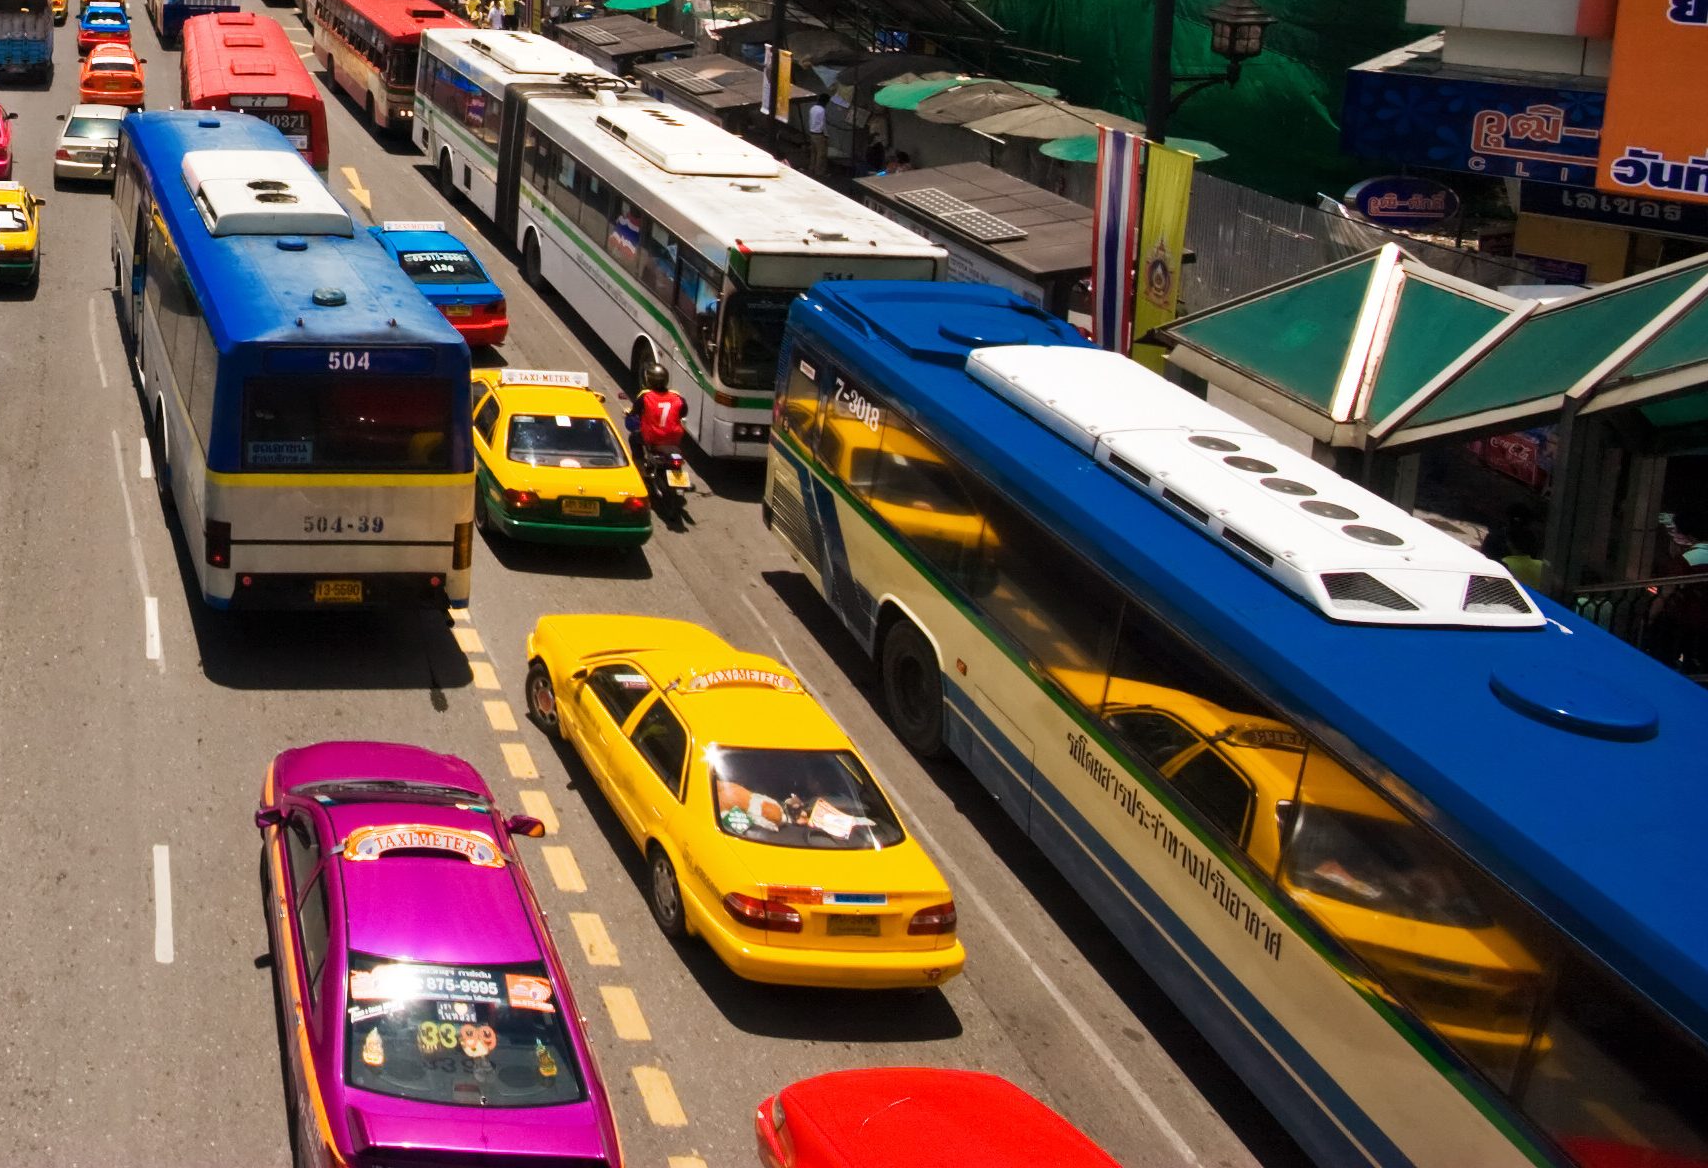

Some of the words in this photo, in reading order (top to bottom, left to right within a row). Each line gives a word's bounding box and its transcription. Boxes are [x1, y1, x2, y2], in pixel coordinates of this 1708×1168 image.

[328, 351, 371, 371] 504
[657, 401, 672, 428] 7
[834, 377, 881, 433] 7-3018
